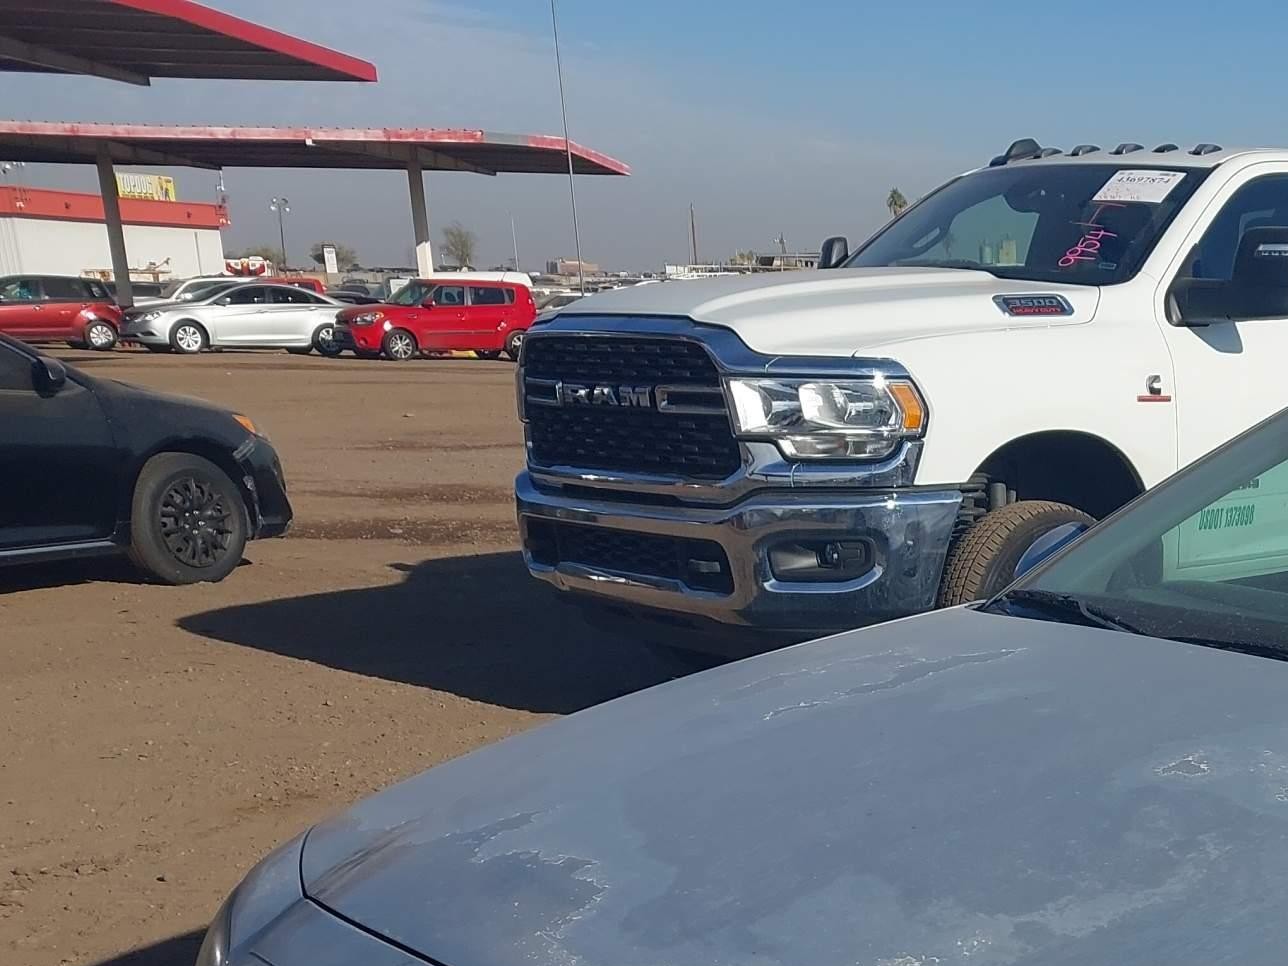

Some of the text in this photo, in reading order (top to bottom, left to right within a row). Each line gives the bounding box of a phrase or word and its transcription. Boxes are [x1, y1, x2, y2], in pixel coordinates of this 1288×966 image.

[1058, 229, 1118, 267] 9954
[562, 382, 651, 408] RAM
[1199, 507, 1224, 530] USDOT
